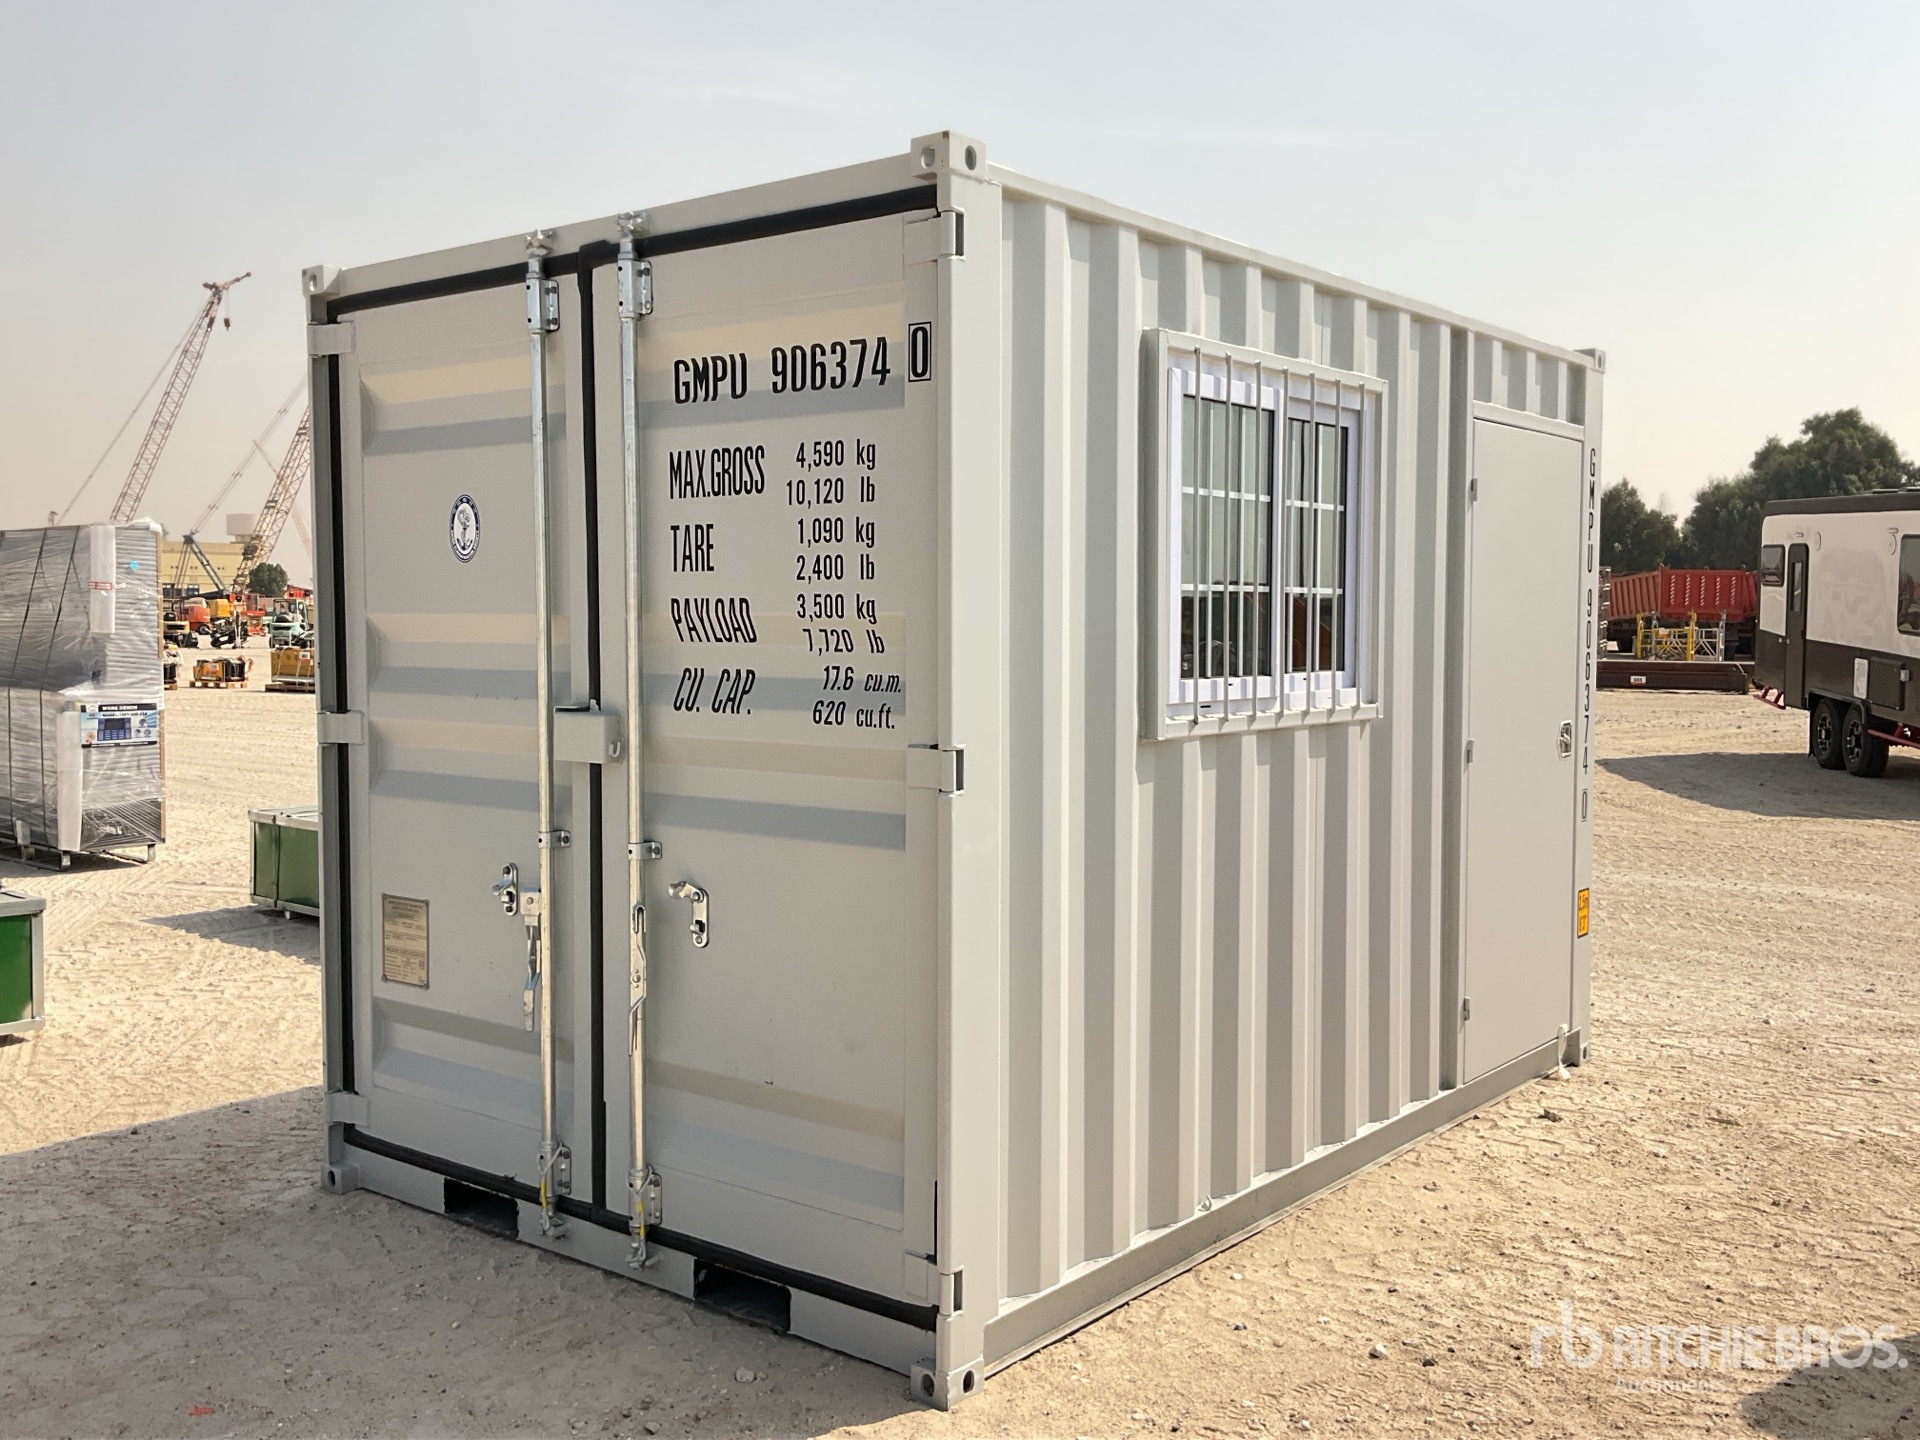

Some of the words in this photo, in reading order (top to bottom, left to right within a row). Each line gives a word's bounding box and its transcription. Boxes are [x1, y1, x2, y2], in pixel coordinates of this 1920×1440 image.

[673, 353, 748, 404] GMPU
[771, 336, 891, 394] 906374
[910, 325, 930, 379] 0
[669, 445, 765, 499] MAX.GROSS
[796, 440, 844, 472] 4,590
[856, 438, 876, 470] kg
[786, 477, 844, 509] 10,120
[860, 476, 875, 503] lb
[1587, 448, 1596, 573] GMPU
[670, 524, 715, 572] TARE
[797, 517, 844, 548] 1,090
[855, 516, 875, 548] kg
[796, 554, 844, 585] 2,400
[860, 554, 875, 580] lb
[670, 597, 757, 643] PAYLOAD
[797, 593, 845, 623] 3,500
[856, 593, 877, 625] kg
[802, 629, 854, 656] 7,720
[866, 629, 885, 654] lb
[673, 667, 705, 712] CU.
[711, 669, 756, 715] CAP.
[823, 666, 854, 691] 17.6
[864, 673, 901, 694] cu.m.
[1582, 588, 1592, 775] 906374
[812, 700, 846, 726] 620
[856, 703, 895, 729] cu.ft.
